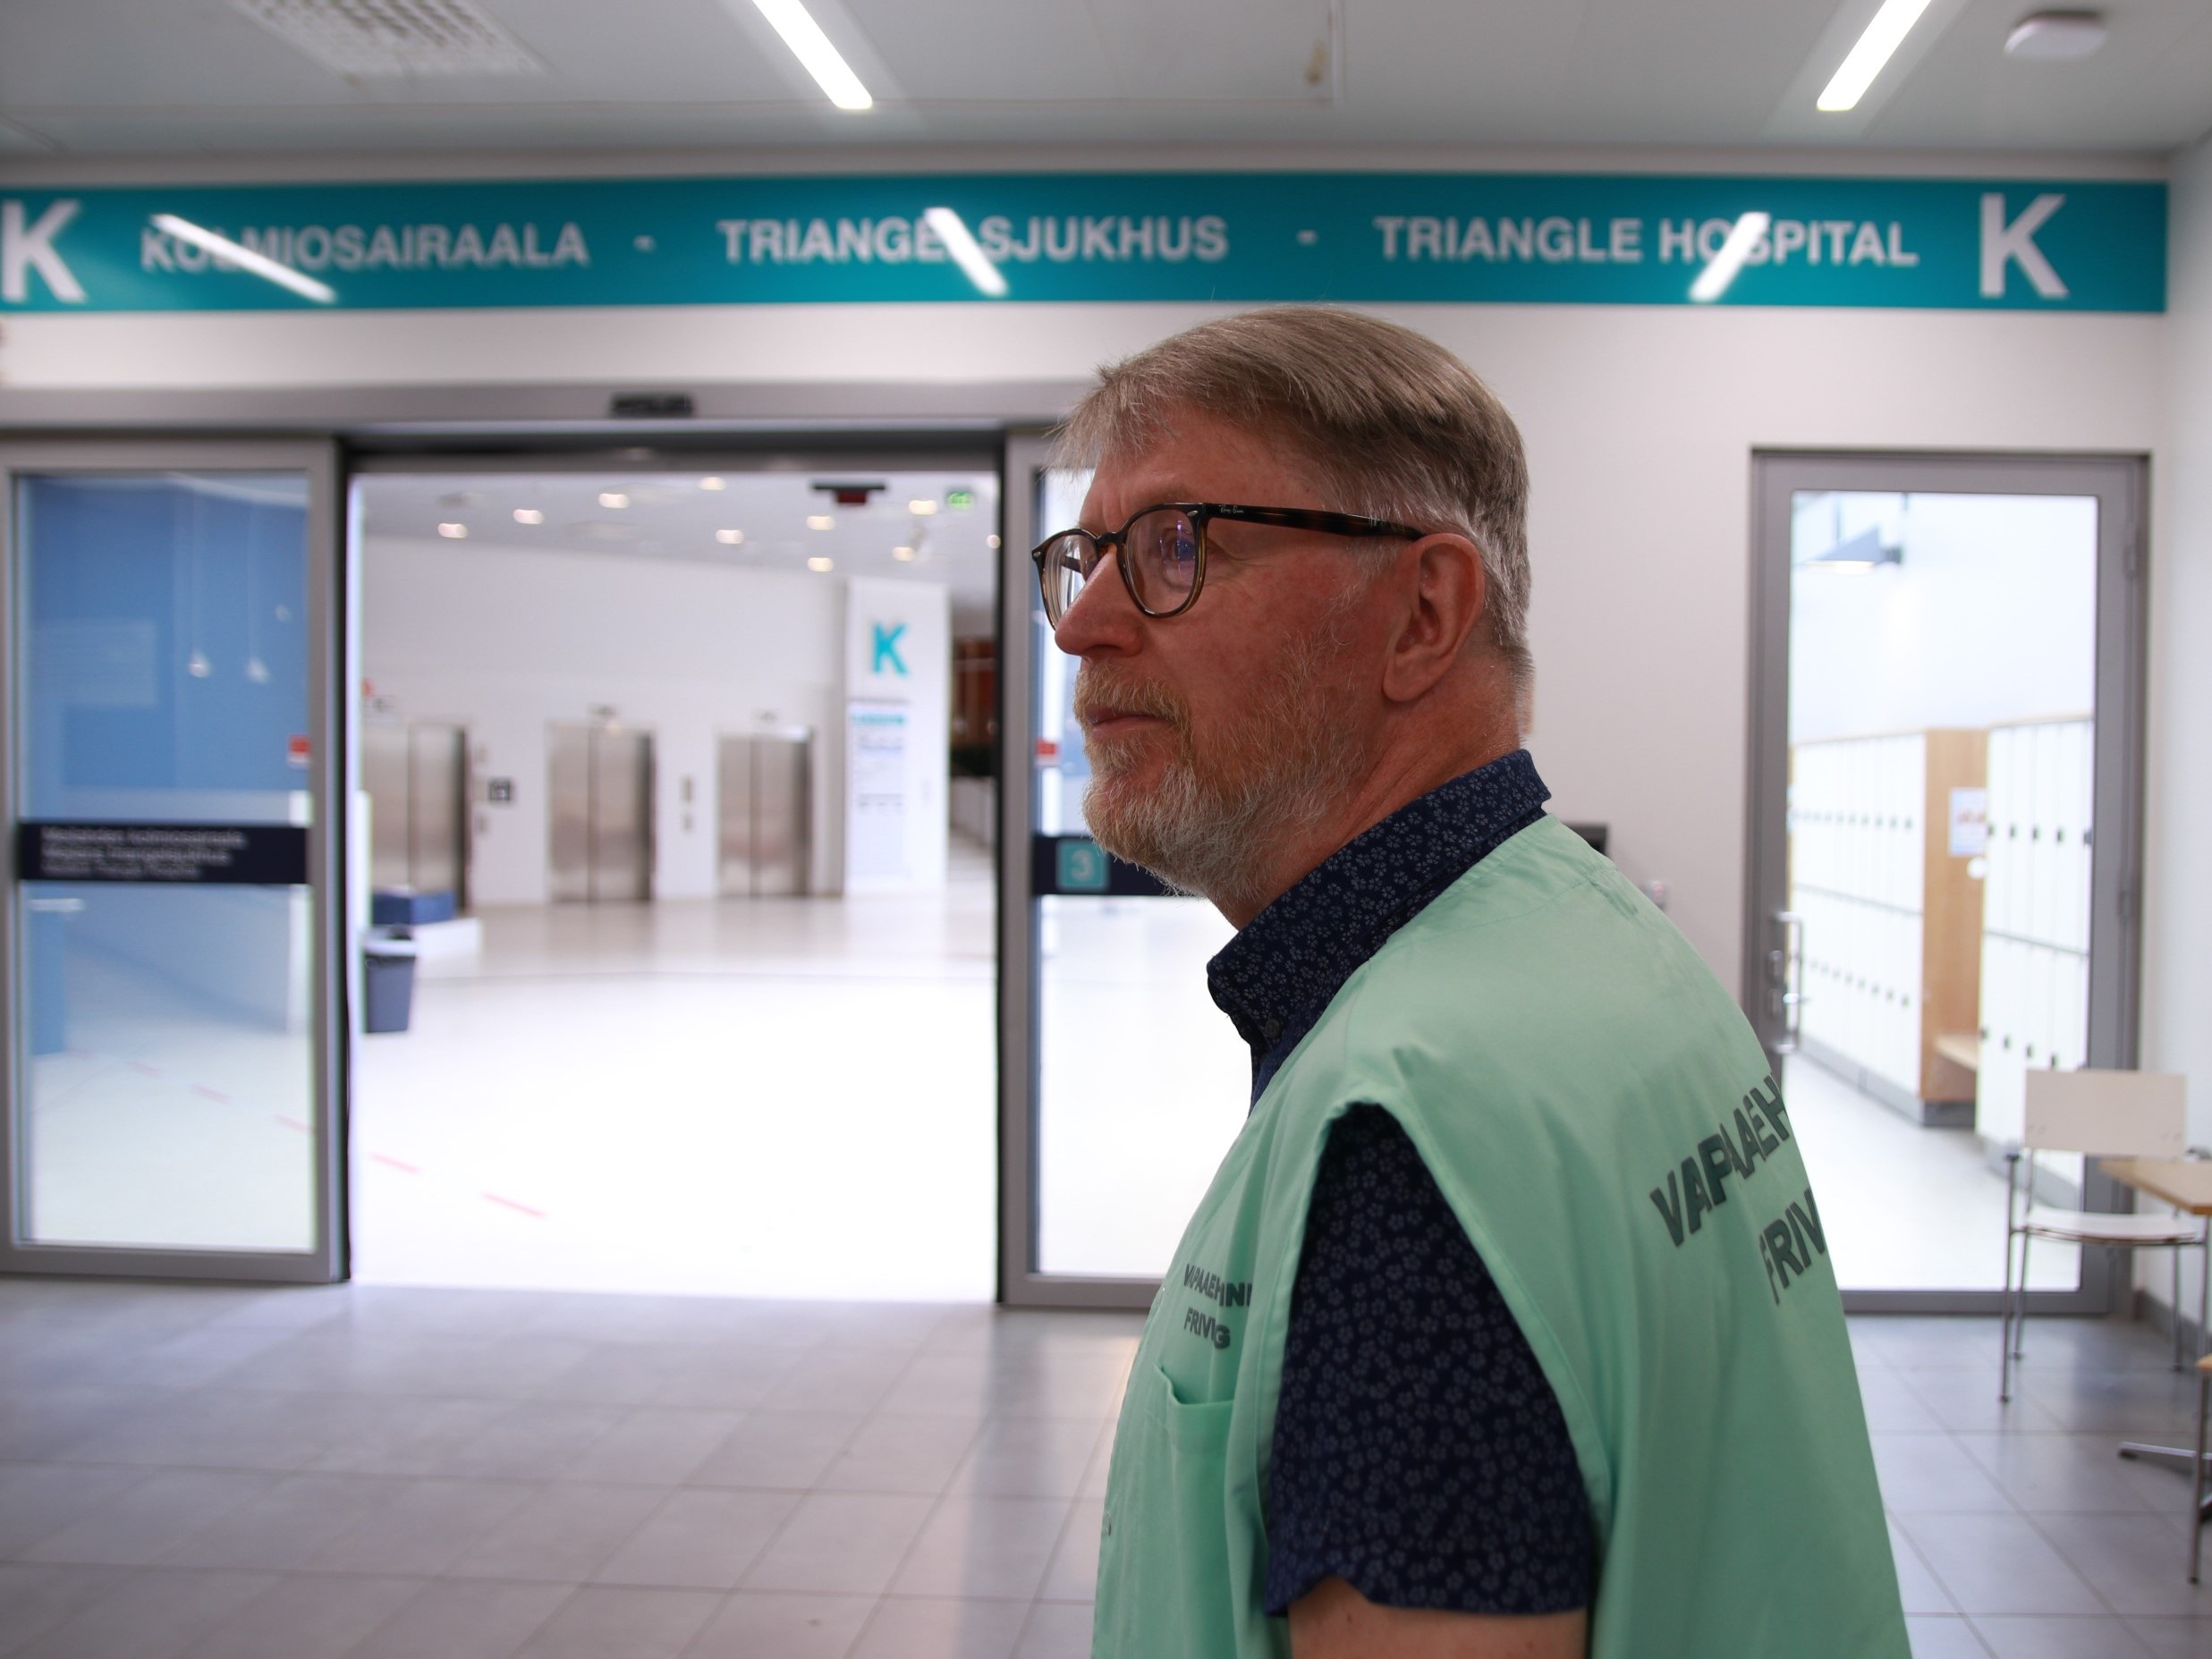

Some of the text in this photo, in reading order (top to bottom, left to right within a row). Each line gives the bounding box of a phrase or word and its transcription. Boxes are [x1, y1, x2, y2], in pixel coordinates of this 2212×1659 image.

[0, 199, 87, 303] K
[140, 222, 589, 272] KOLMIOSAIRAALA
[718, 216, 1228, 264] TRIANGESJUKHUS
[1374, 216, 1641, 264] TRIANGLE
[1979, 192, 2069, 300] K
[870, 623, 908, 674] K
